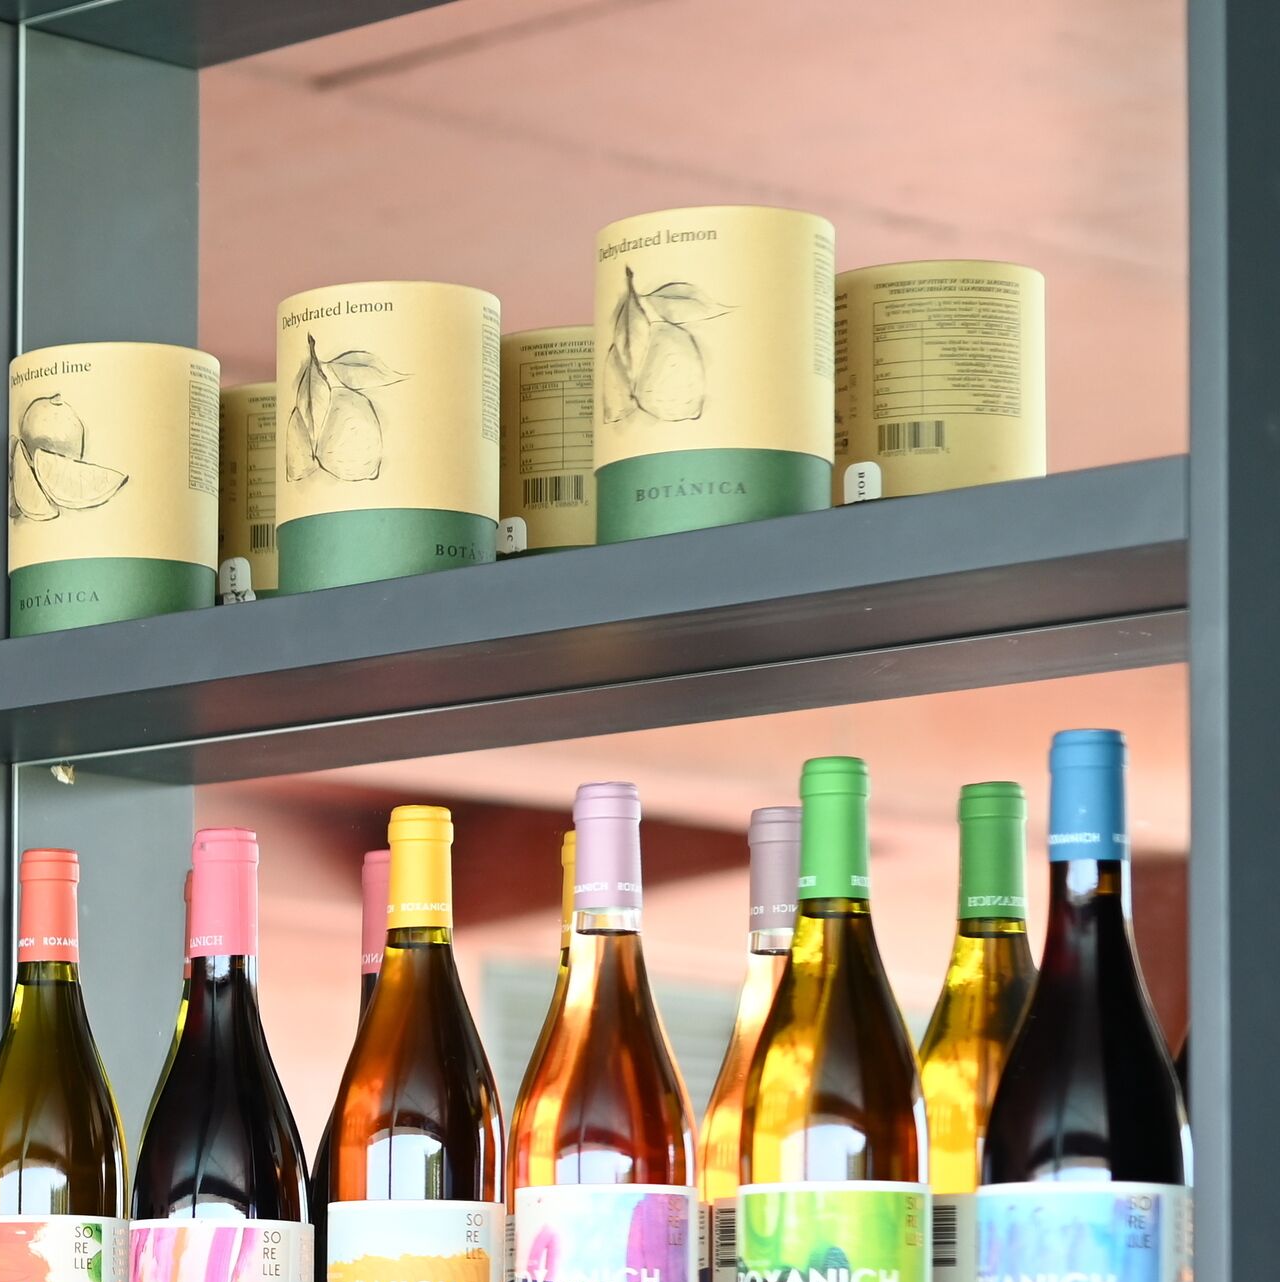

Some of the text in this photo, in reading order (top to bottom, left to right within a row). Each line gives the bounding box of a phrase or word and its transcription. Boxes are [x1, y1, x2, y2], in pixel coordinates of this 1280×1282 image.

[666, 229, 717, 243] lemon
[282, 301, 393, 329] Dehydrated lemon
[62, 360, 91, 374] lime
[636, 478, 747, 502] BOTÁNICA
[435, 543, 486, 560] BOTÁN
[20, 589, 100, 610] BOTÁNICA
[400, 902, 450, 912] ROXANIC
[466, 1213, 483, 1227] SO
[75, 1226, 93, 1239] SO
[263, 1231, 282, 1244] SO
[466, 1230, 480, 1243] RE
[74, 1242, 89, 1254] RE
[263, 1248, 276, 1260] RE
[74, 1258, 93, 1270] LLE
[262, 1264, 280, 1276] LLE
